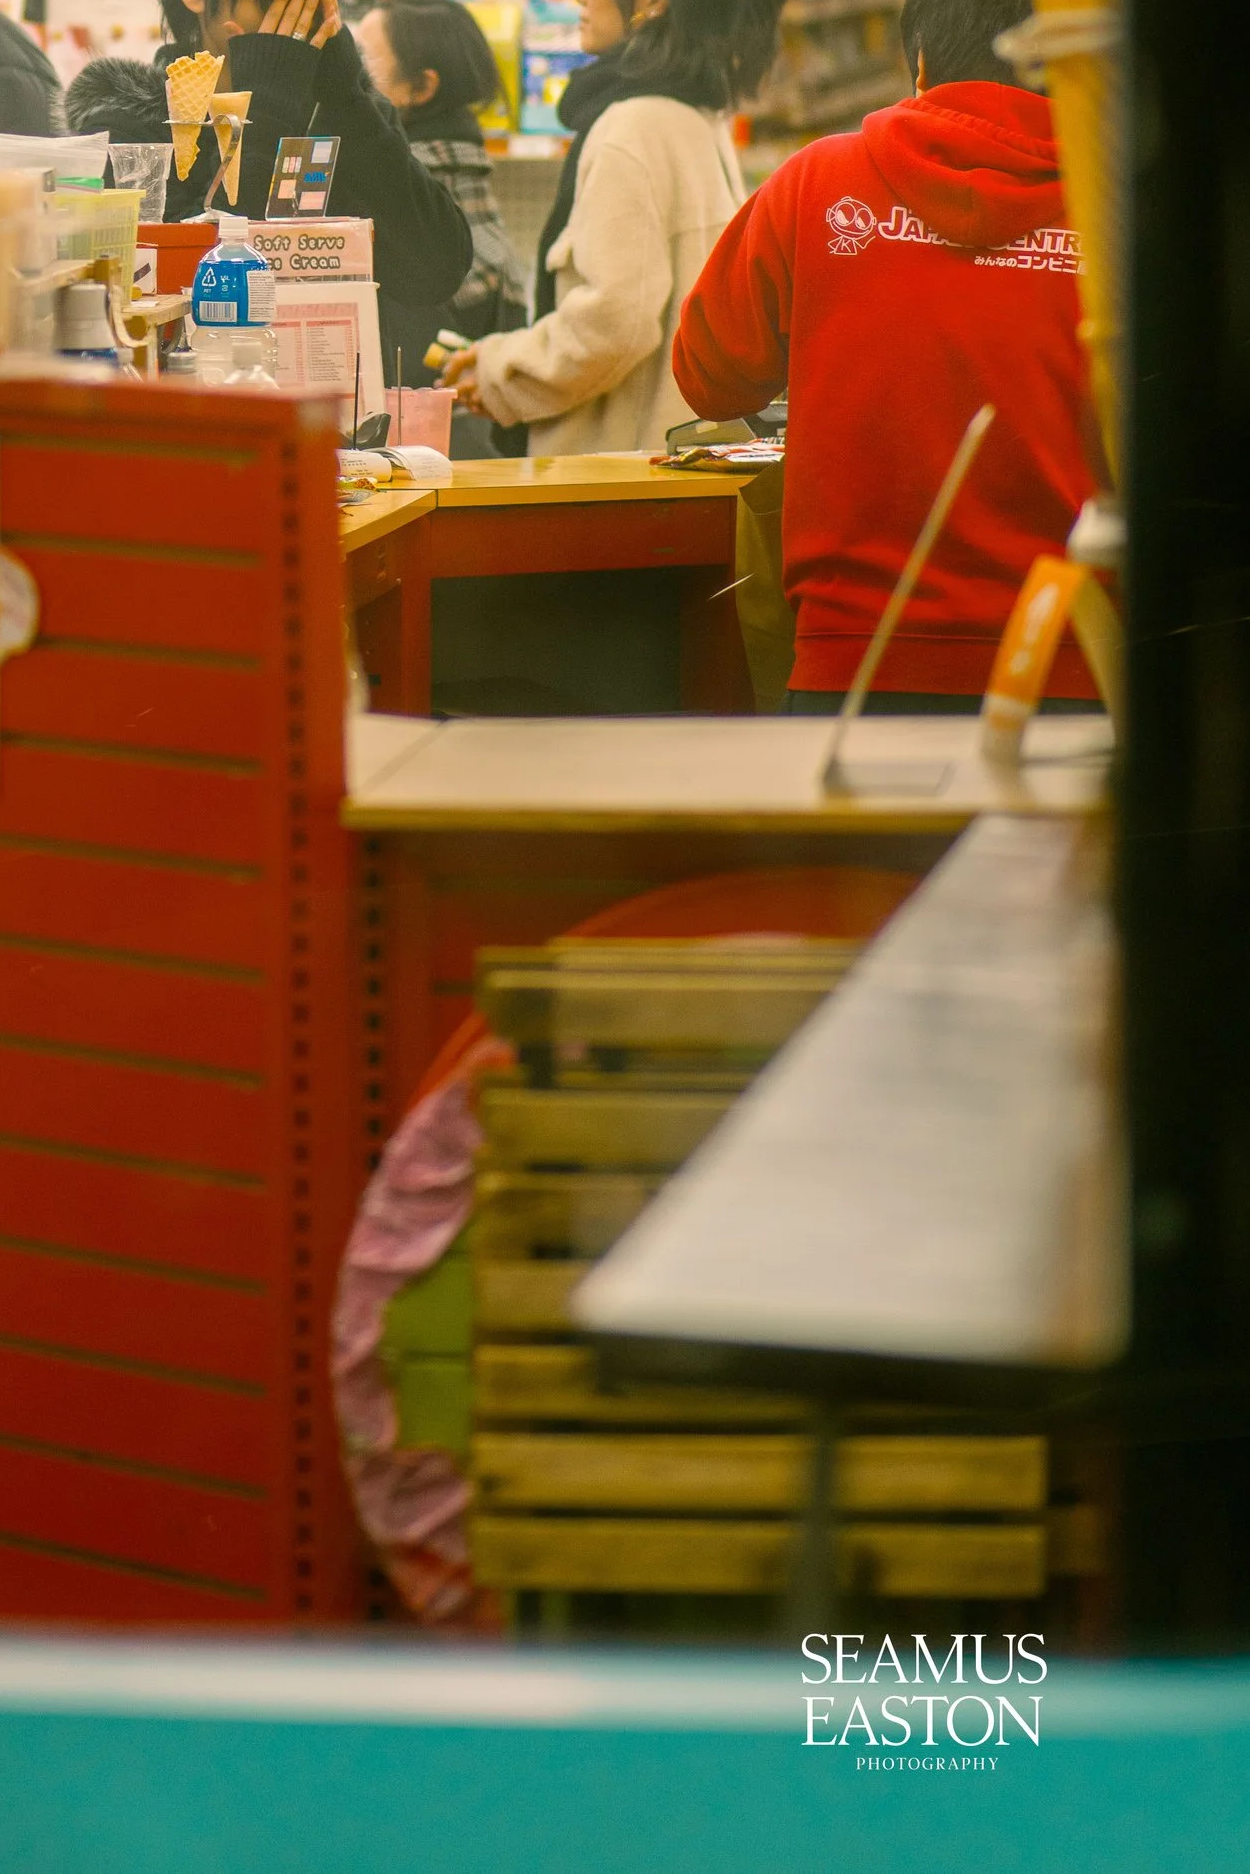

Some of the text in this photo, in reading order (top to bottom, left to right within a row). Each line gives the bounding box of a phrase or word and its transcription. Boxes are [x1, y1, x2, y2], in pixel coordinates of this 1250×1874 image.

[254, 233, 346, 252] Soft Serve
[290, 253, 341, 270] Cream
